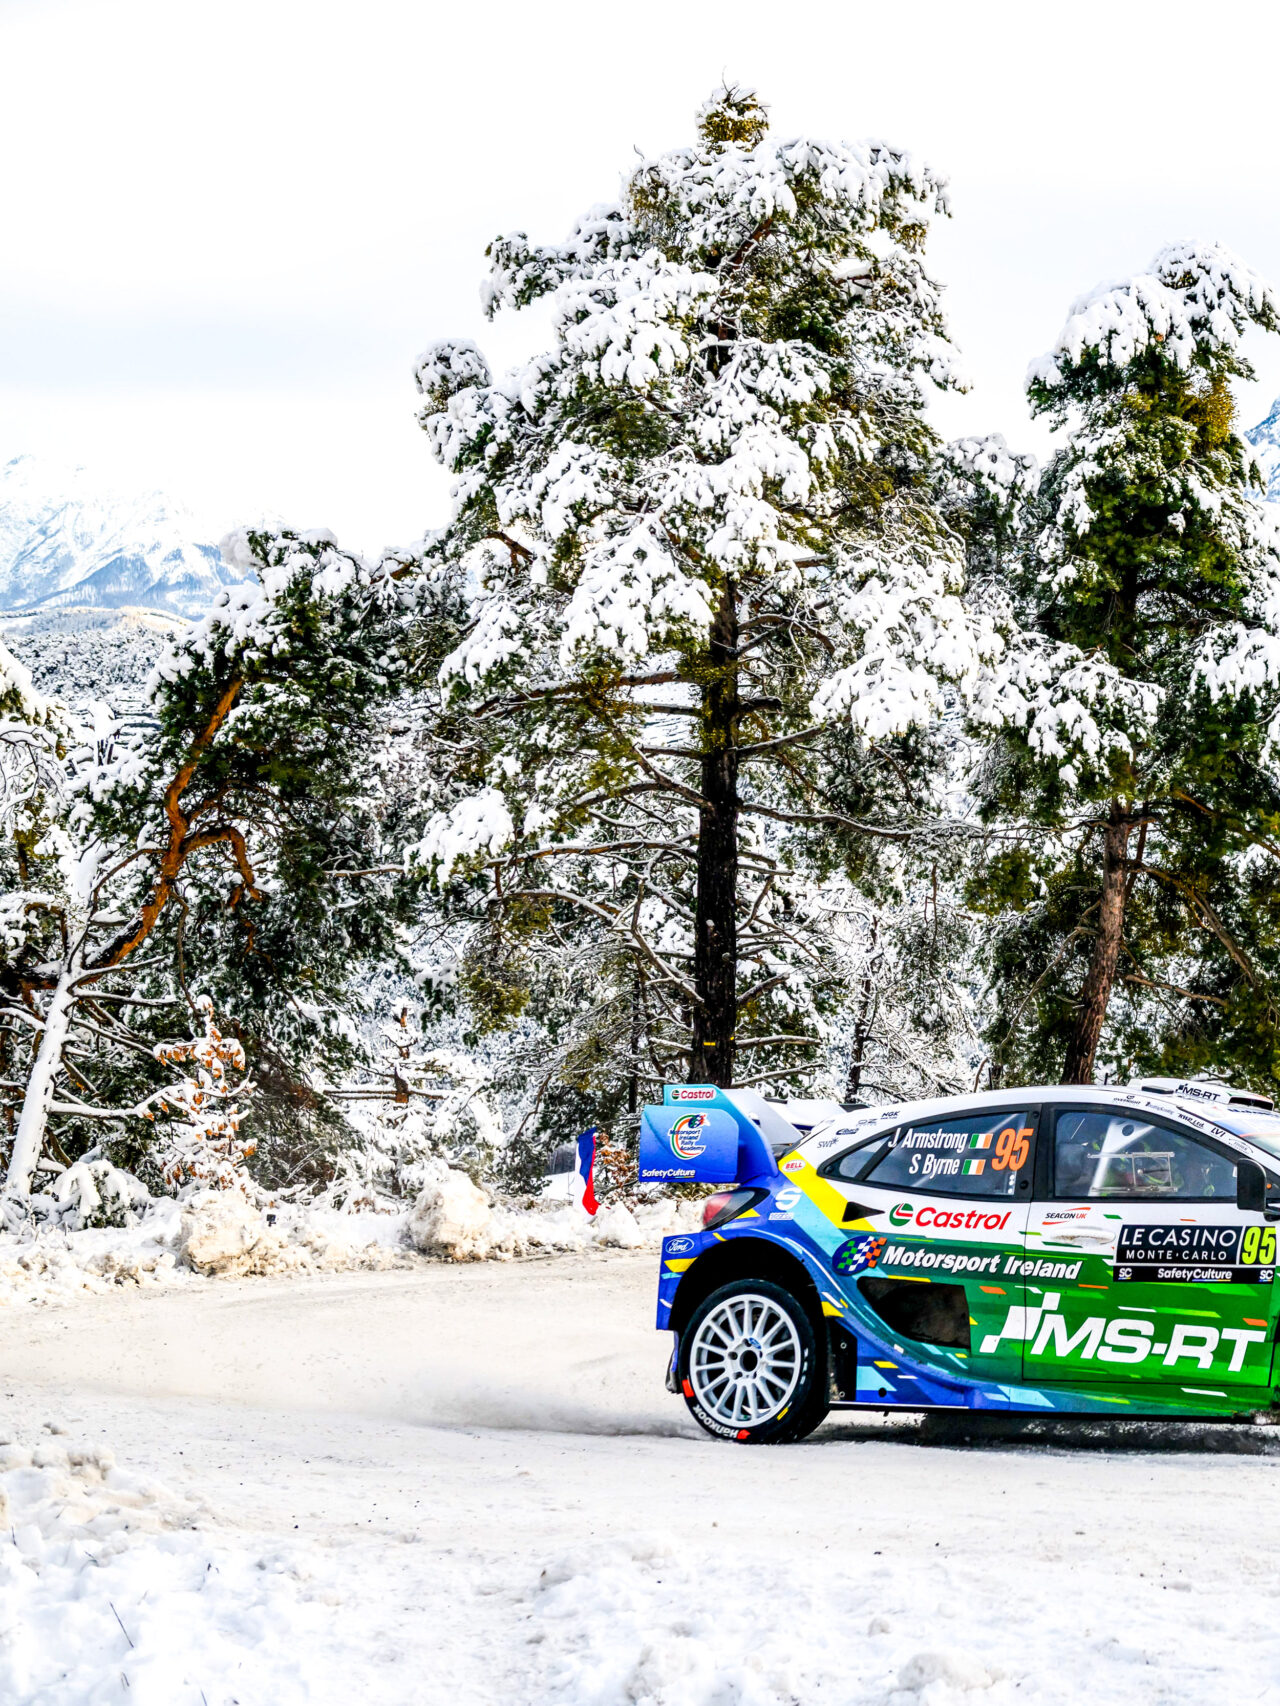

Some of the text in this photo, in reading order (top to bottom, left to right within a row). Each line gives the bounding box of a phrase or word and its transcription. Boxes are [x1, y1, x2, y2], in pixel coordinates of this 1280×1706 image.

[680, 1089, 714, 1099] Castrol
[888, 1128, 1034, 1171] J Armstrong 95
[642, 1168, 696, 1178] SafetyCulture
[908, 1153, 960, 1179] S Byrne
[915, 1207, 1012, 1230] Castrol
[669, 1239, 690, 1252] Ford
[1121, 1228, 1237, 1248] LE CASINO
[1241, 1226, 1276, 1265] 95
[882, 1245, 1083, 1280] Motorsport Ireland
[1118, 1268, 1132, 1278] SC
[1157, 1268, 1232, 1281] SafetyCulture
[1259, 1269, 1274, 1280] SC
[1030, 1314, 1267, 1372] MS-RT
